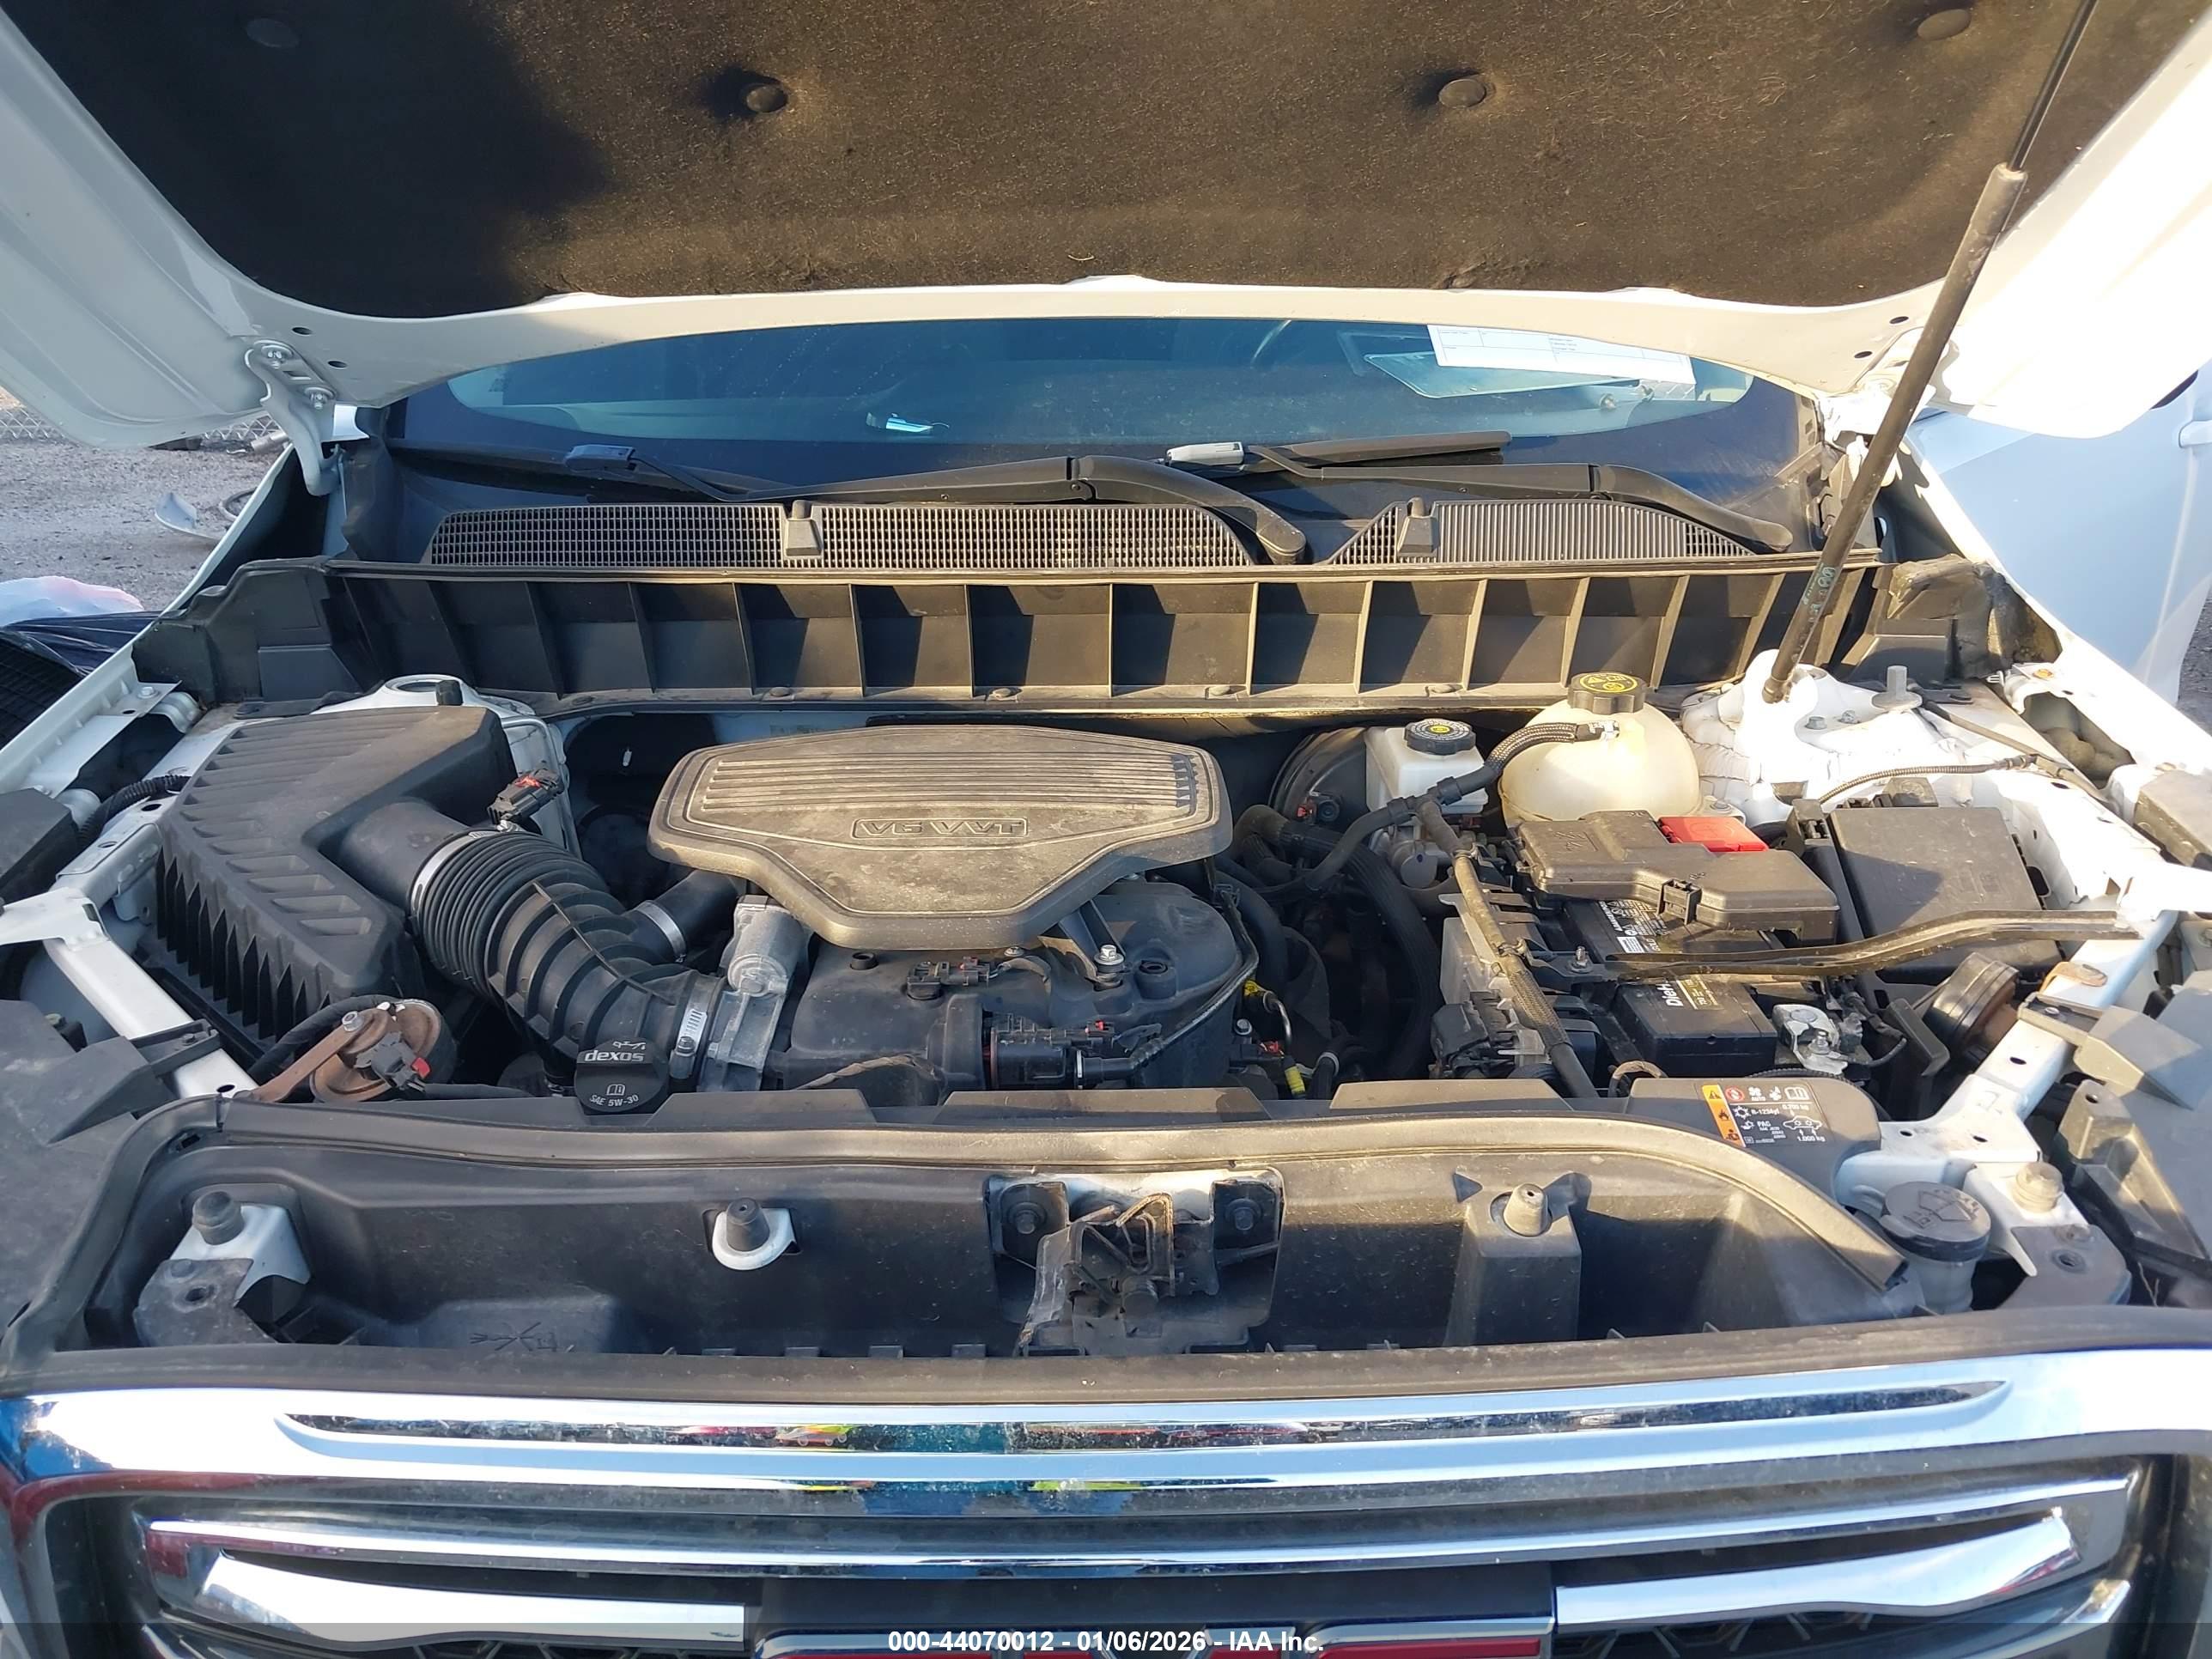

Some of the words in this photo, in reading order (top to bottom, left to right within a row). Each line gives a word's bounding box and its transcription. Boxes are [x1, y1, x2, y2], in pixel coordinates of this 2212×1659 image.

[860, 822, 922, 835] V6
[929, 820, 1022, 835] VVT
[584, 1049, 645, 1062] dexos
[589, 1094, 606, 1106] SAE
[608, 1094, 639, 1107] 5W-30
